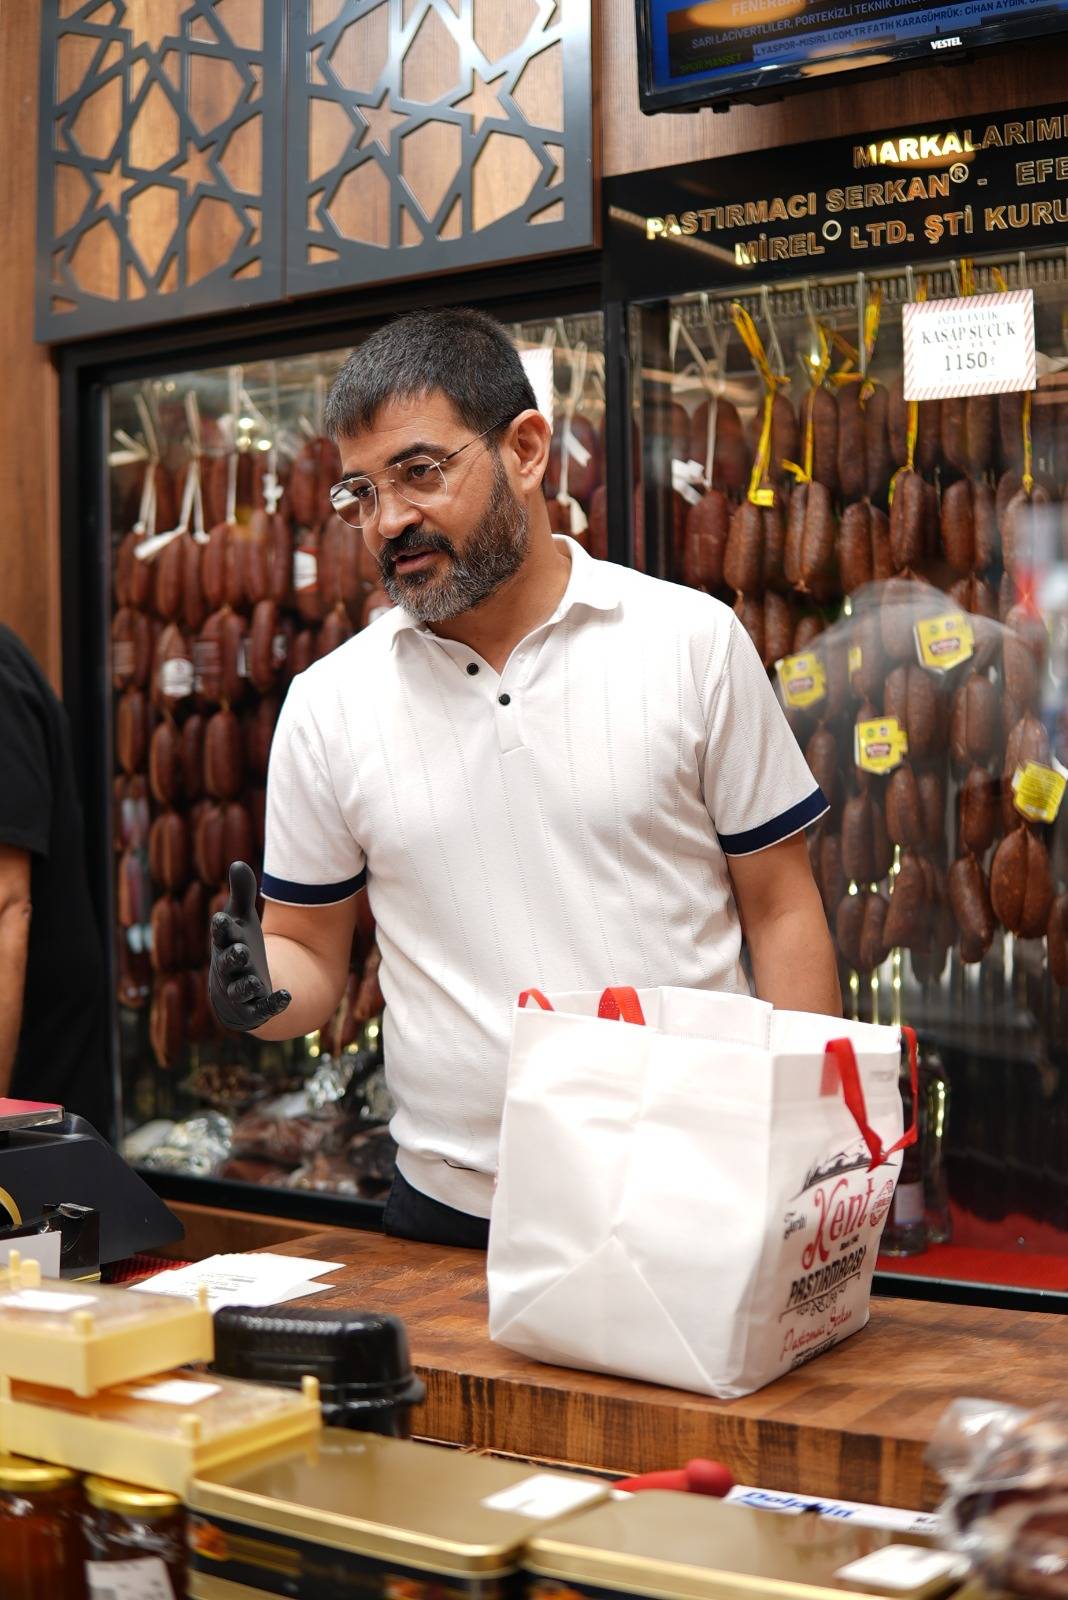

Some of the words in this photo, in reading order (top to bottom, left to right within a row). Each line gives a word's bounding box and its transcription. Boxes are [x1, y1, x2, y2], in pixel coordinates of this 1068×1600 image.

[930, 36, 963, 50] VESTEL
[646, 191, 817, 240] PASTIRMACI
[850, 219, 915, 250] LTD.
[924, 204, 974, 245] ŞTİ
[984, 199, 1068, 232] KURU
[741, 1489, 854, 1519] Dolpin
